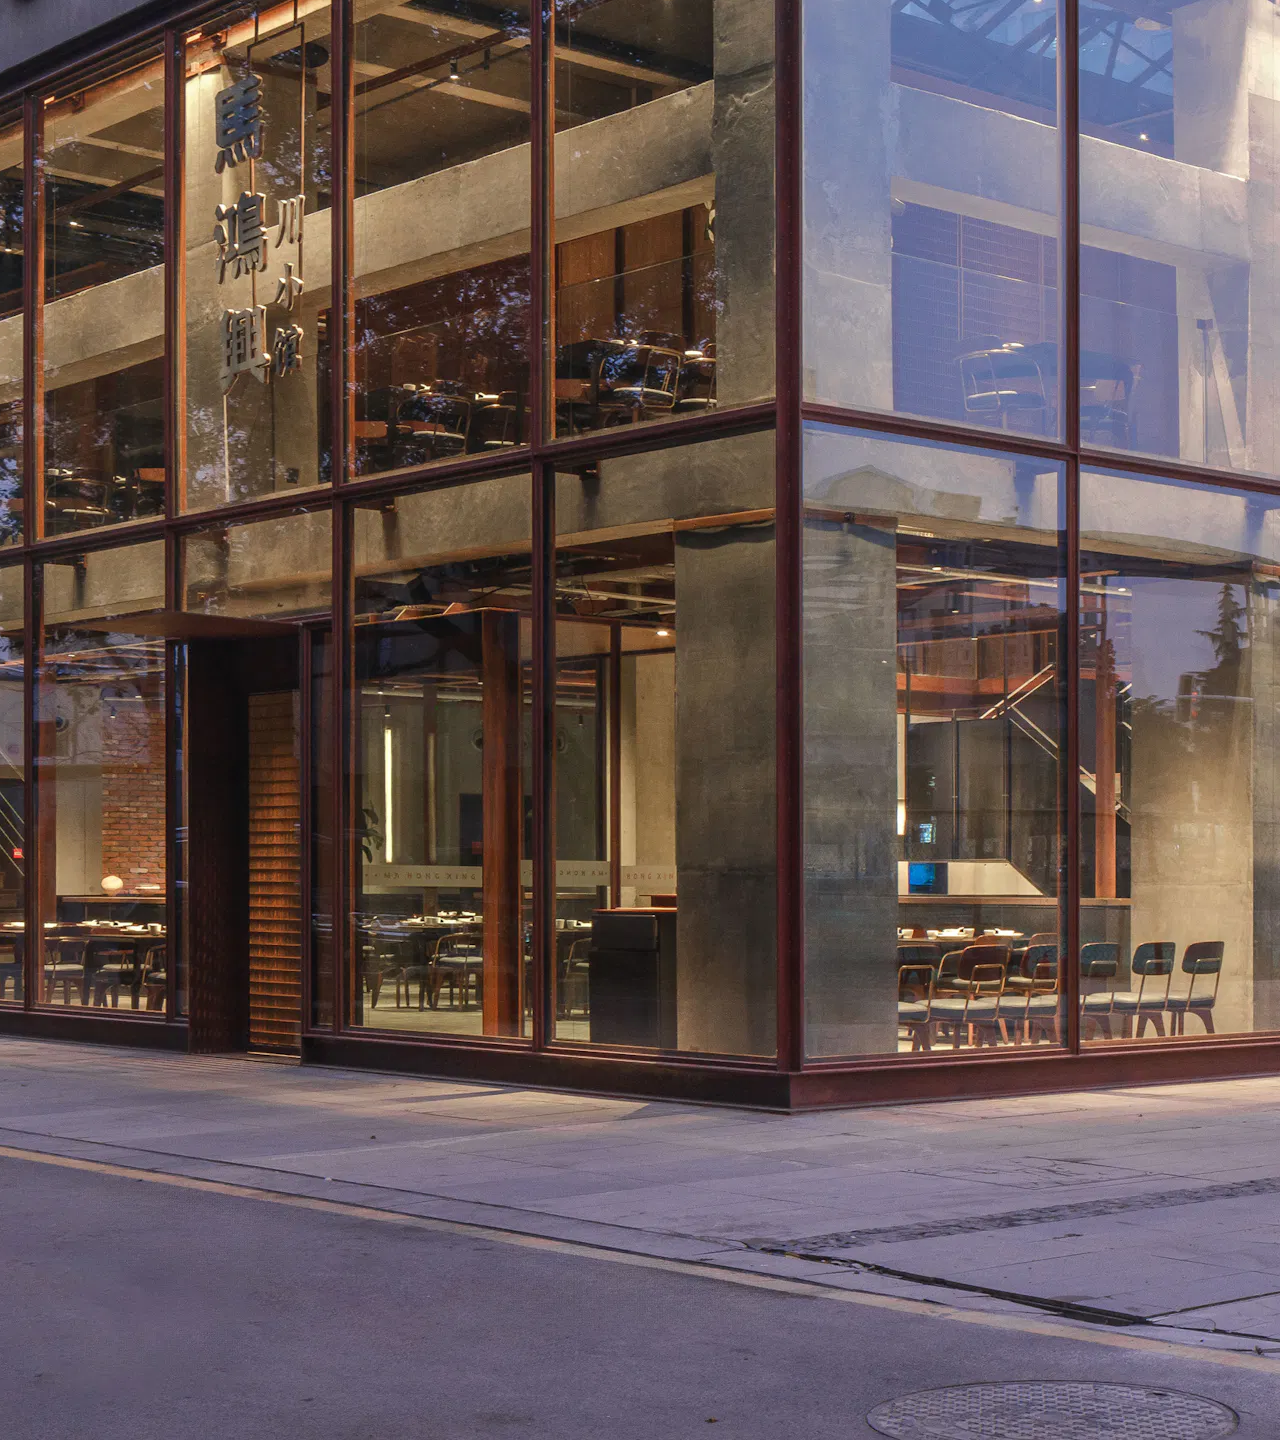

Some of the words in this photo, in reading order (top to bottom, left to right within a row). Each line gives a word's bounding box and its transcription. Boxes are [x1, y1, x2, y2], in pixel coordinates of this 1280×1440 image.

[214, 73, 271, 395] 馬鴻興
[407, 872, 440, 880] HONG
[446, 873, 476, 881] XING
